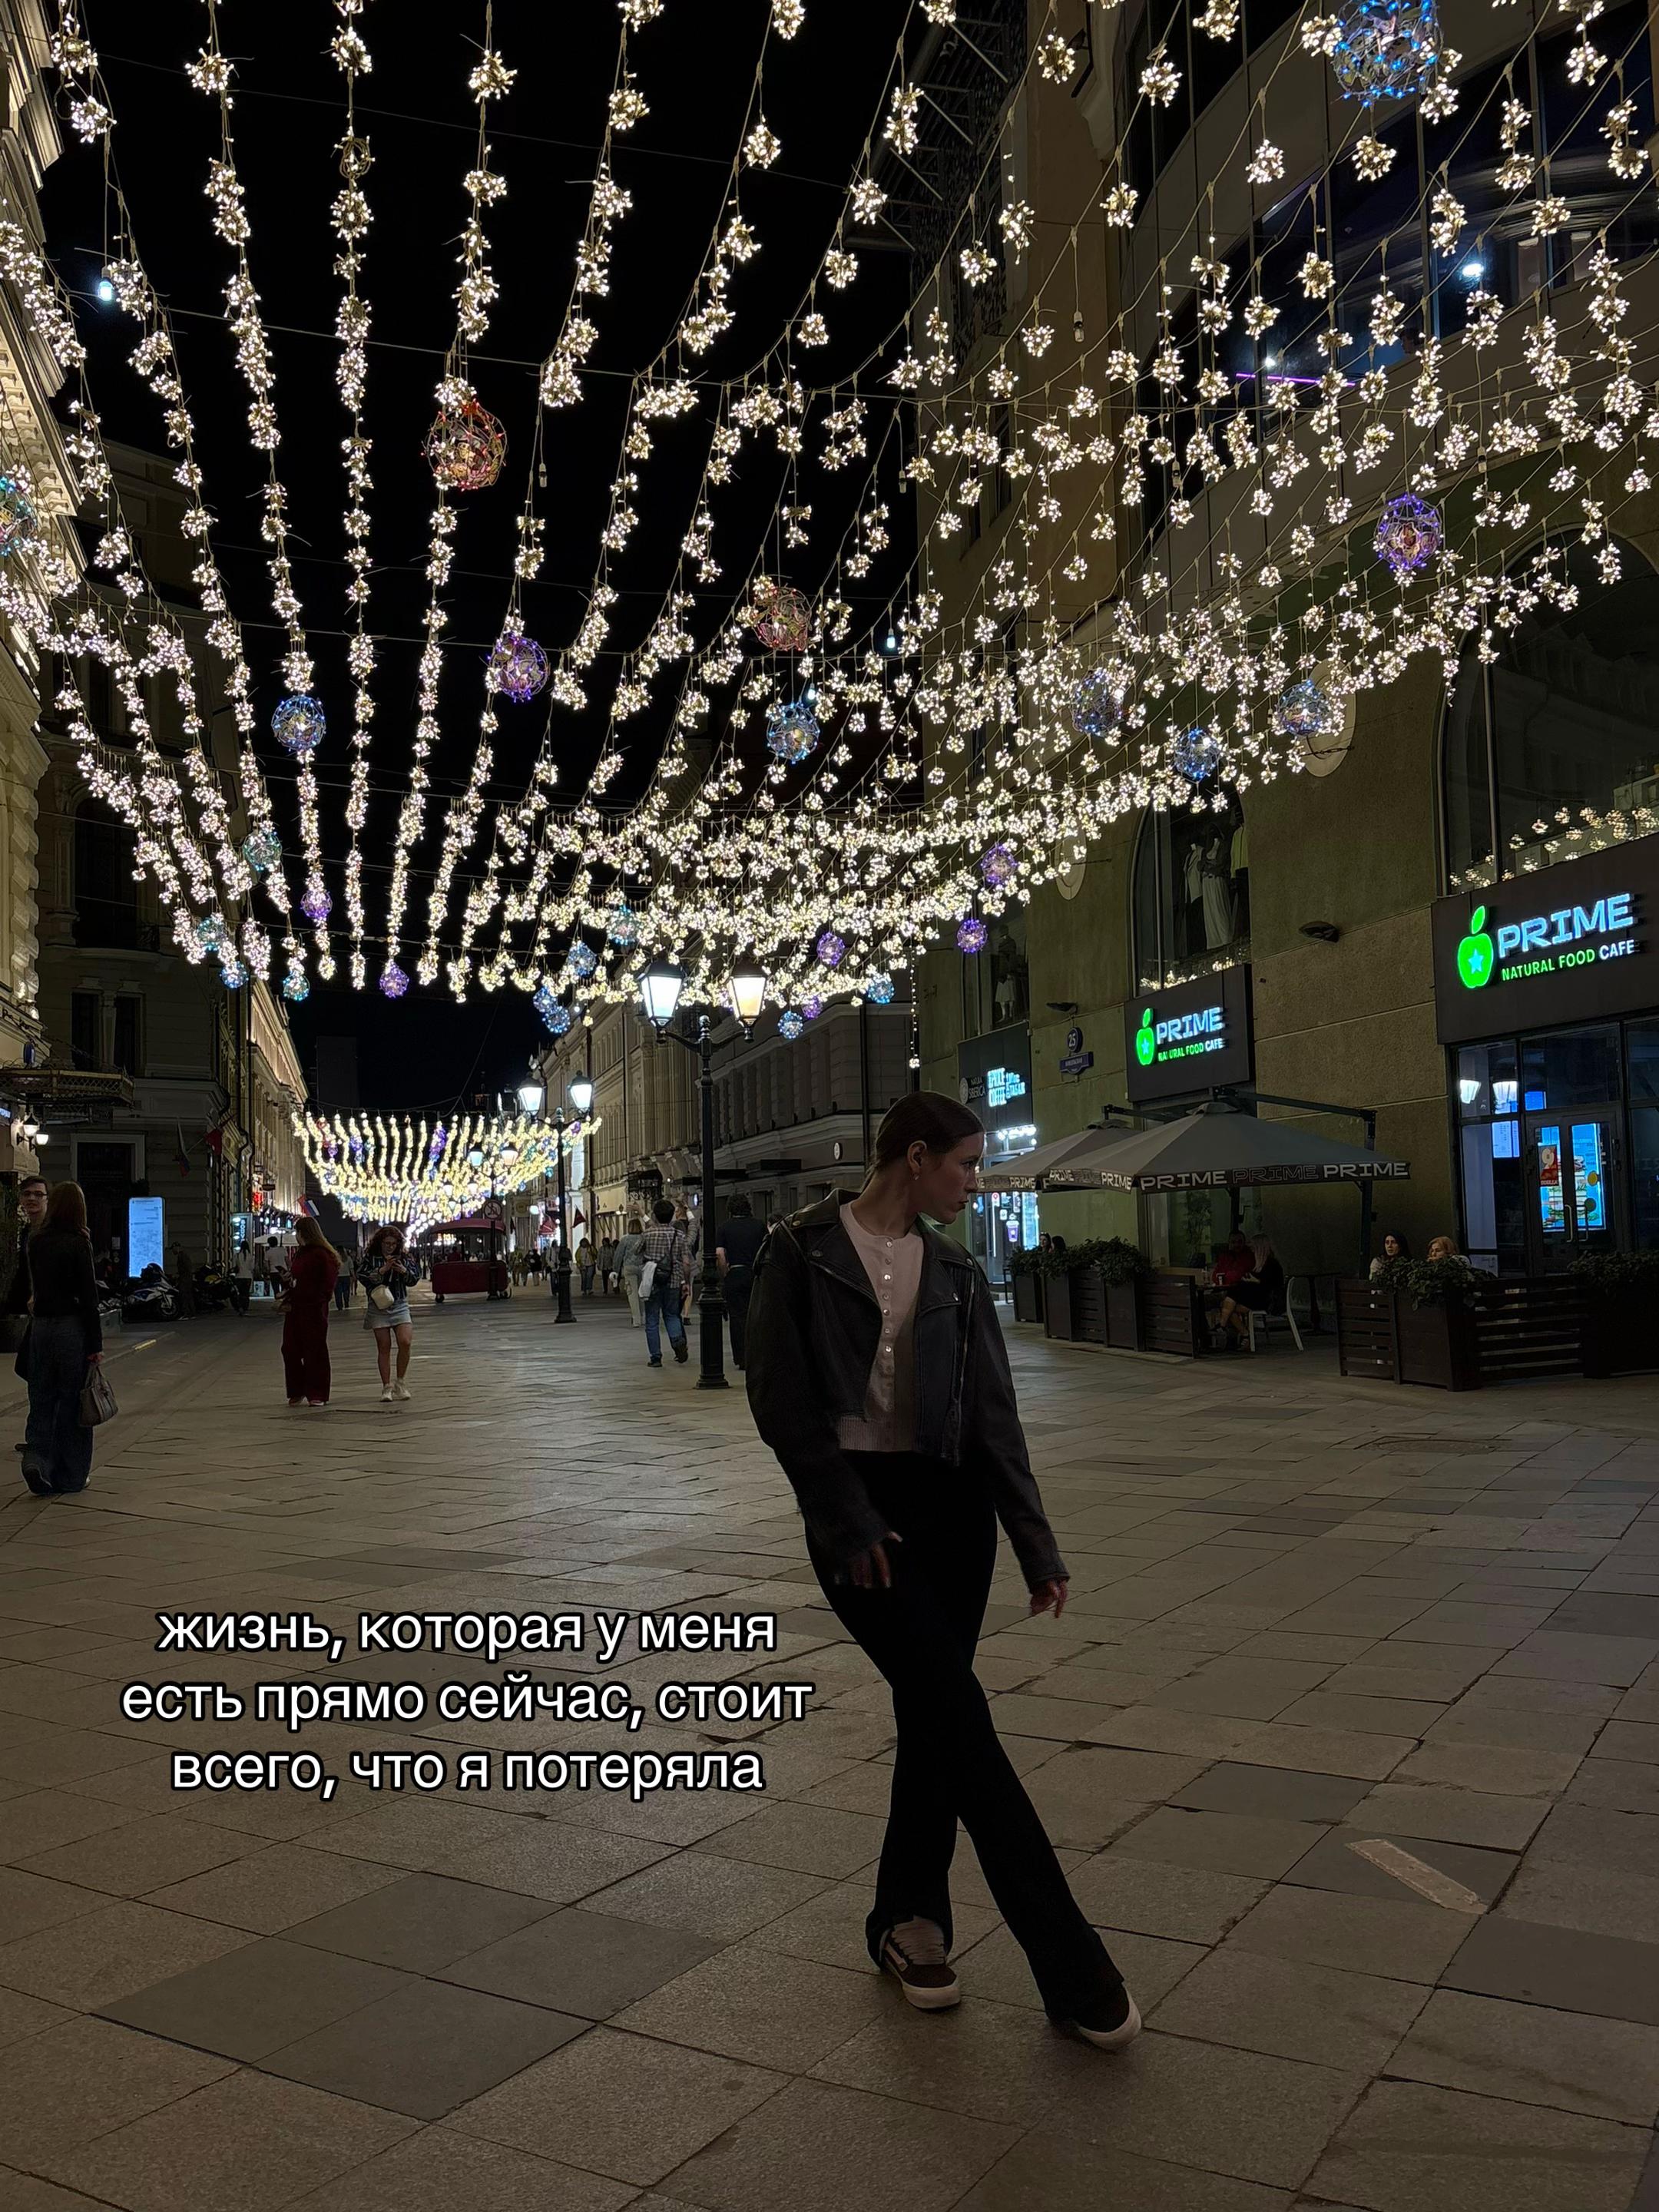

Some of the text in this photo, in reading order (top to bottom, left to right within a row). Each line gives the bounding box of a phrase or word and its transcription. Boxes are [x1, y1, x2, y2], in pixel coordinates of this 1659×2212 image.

[1498, 892, 1635, 959] PRIME
[1502, 939, 1636, 981] NATURAL FOOD CAFE
[1156, 1006, 1224, 1045] PRIME
[1068, 1032, 1077, 1048] 25
[1185, 1042, 1204, 1055] FOOD
[1204, 1038, 1224, 1052] CAFE
[1009, 1177, 1036, 1190] PRIME
[1048, 1169, 1075, 1182] PRIME
[1101, 1172, 1132, 1190] PRIME
[1139, 1162, 1409, 1191] PRIME PRIME PRIME
